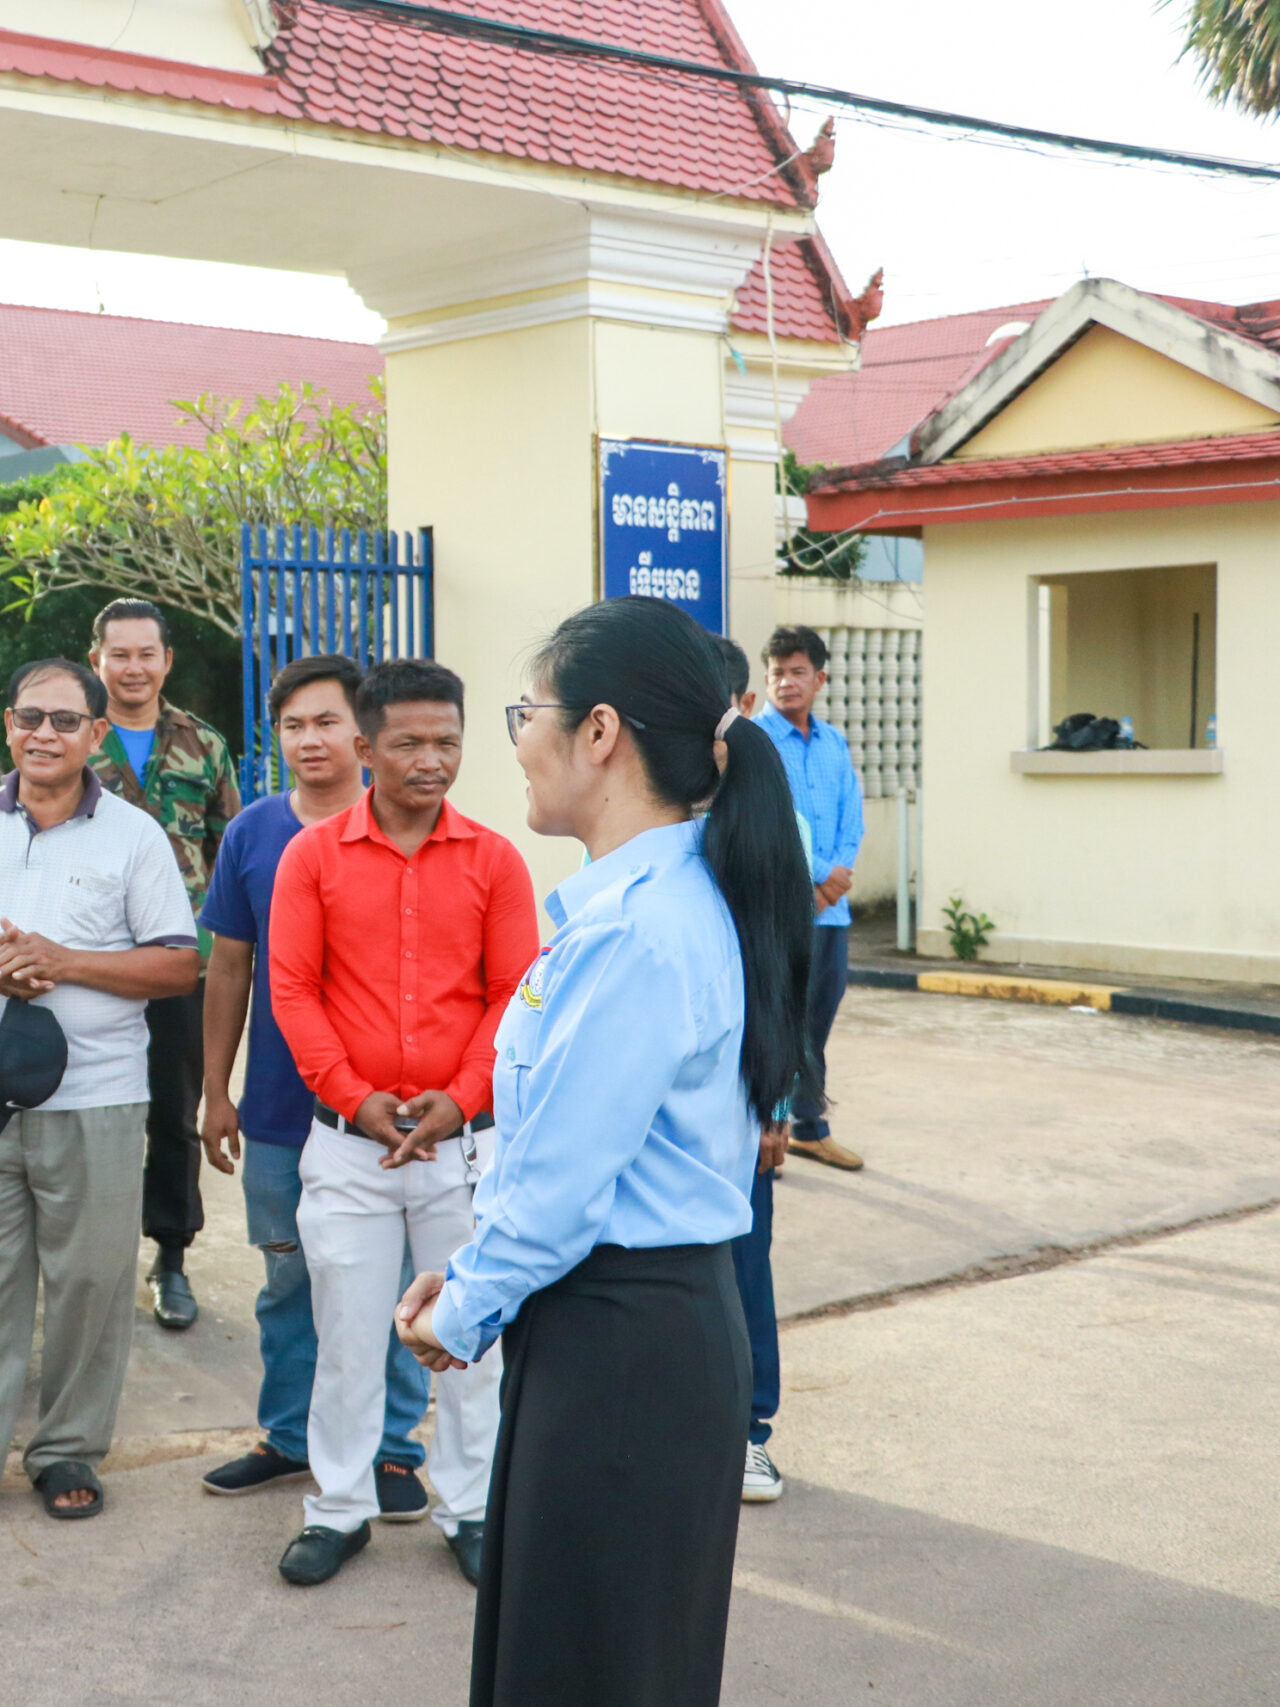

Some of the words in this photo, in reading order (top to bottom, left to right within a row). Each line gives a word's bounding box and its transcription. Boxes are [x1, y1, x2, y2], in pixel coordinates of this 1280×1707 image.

[612, 482, 715, 542] មានសន្តិភាព
